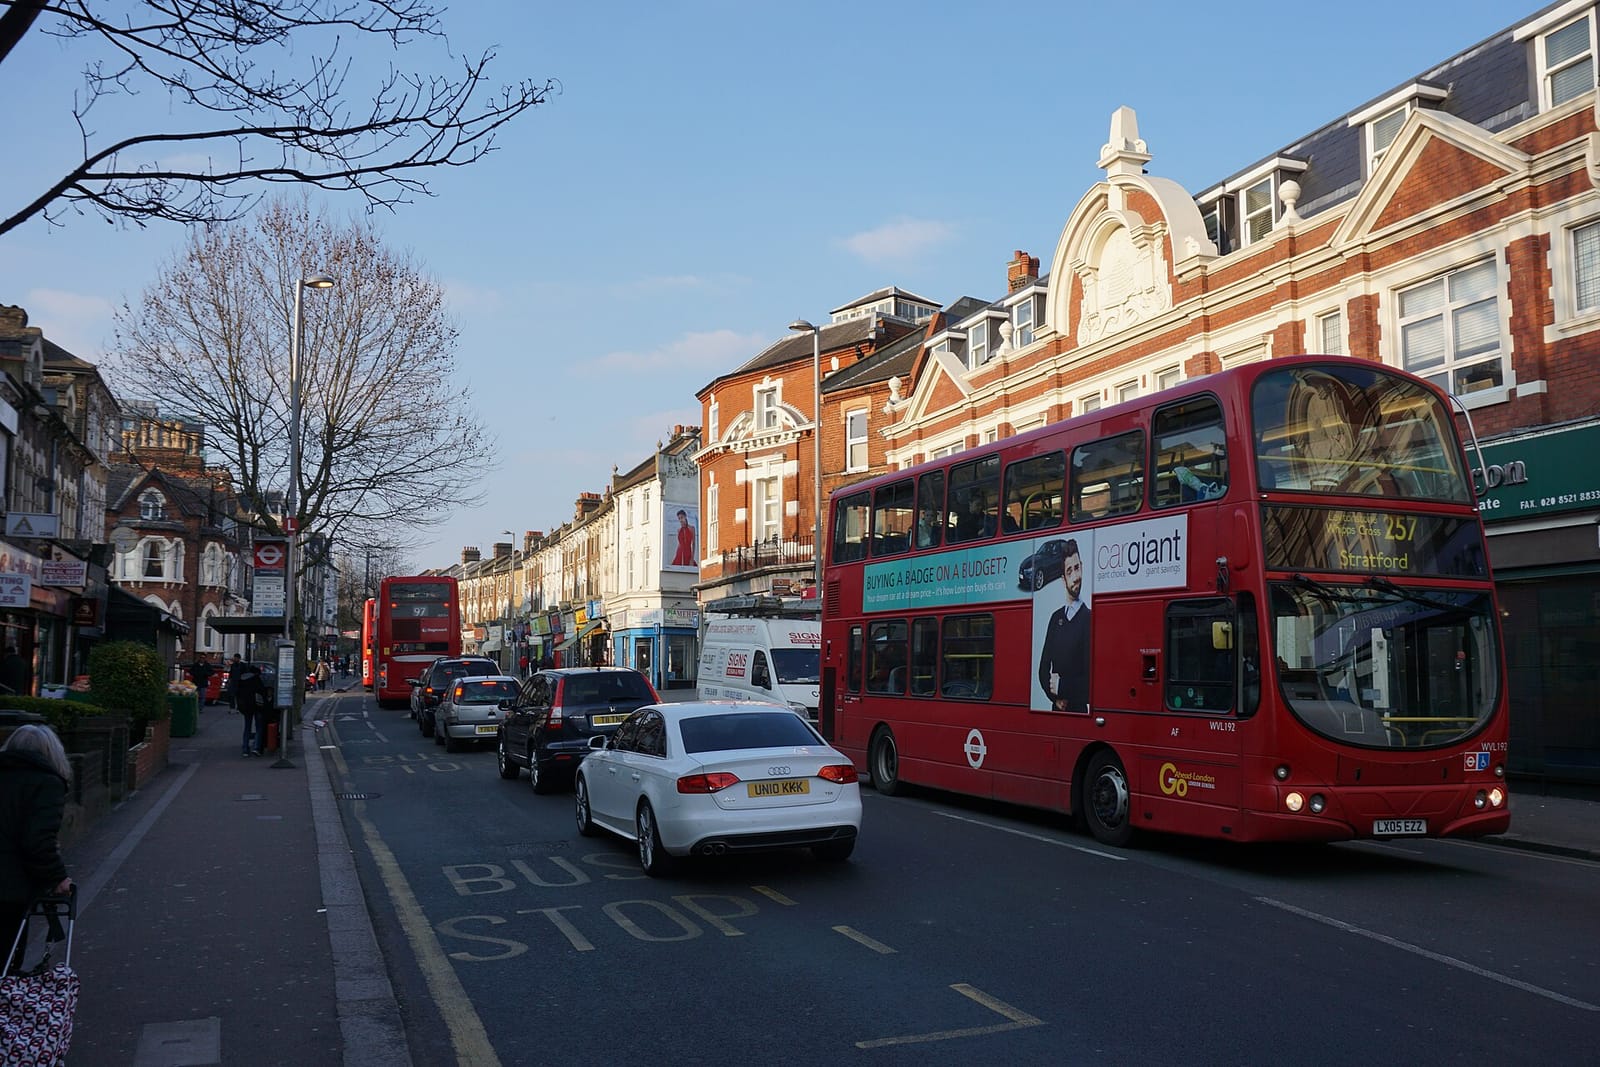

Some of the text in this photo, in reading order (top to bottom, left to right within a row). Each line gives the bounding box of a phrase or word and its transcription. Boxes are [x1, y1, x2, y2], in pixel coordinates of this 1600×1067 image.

[1520, 500, 1538, 510] FAX.
[1540, 496, 1556, 507] 020
[1558, 494, 1577, 504] 8521
[1579, 490, 1600, 501] 8833
[1358, 525, 1381, 536] Cross
[1384, 515, 1417, 541] 257
[1098, 529, 1181, 575] cargiant
[1340, 549, 1408, 569] Stratford
[866, 556, 1008, 590] BUYING A BADGE ON A BUDGET?
[1146, 567, 1161, 577] giant
[974, 582, 987, 594] buys
[413, 607, 426, 616] 97
[788, 632, 822, 640] SIGN
[727, 653, 748, 667] SIGNS
[1170, 721, 1236, 737] AF WVL192
[1481, 741, 1508, 751] WVL192
[782, 781, 804, 794] KKK
[1376, 822, 1423, 833] LX05 EZZ
[441, 852, 646, 897] BUS
[433, 893, 761, 962] STOP
